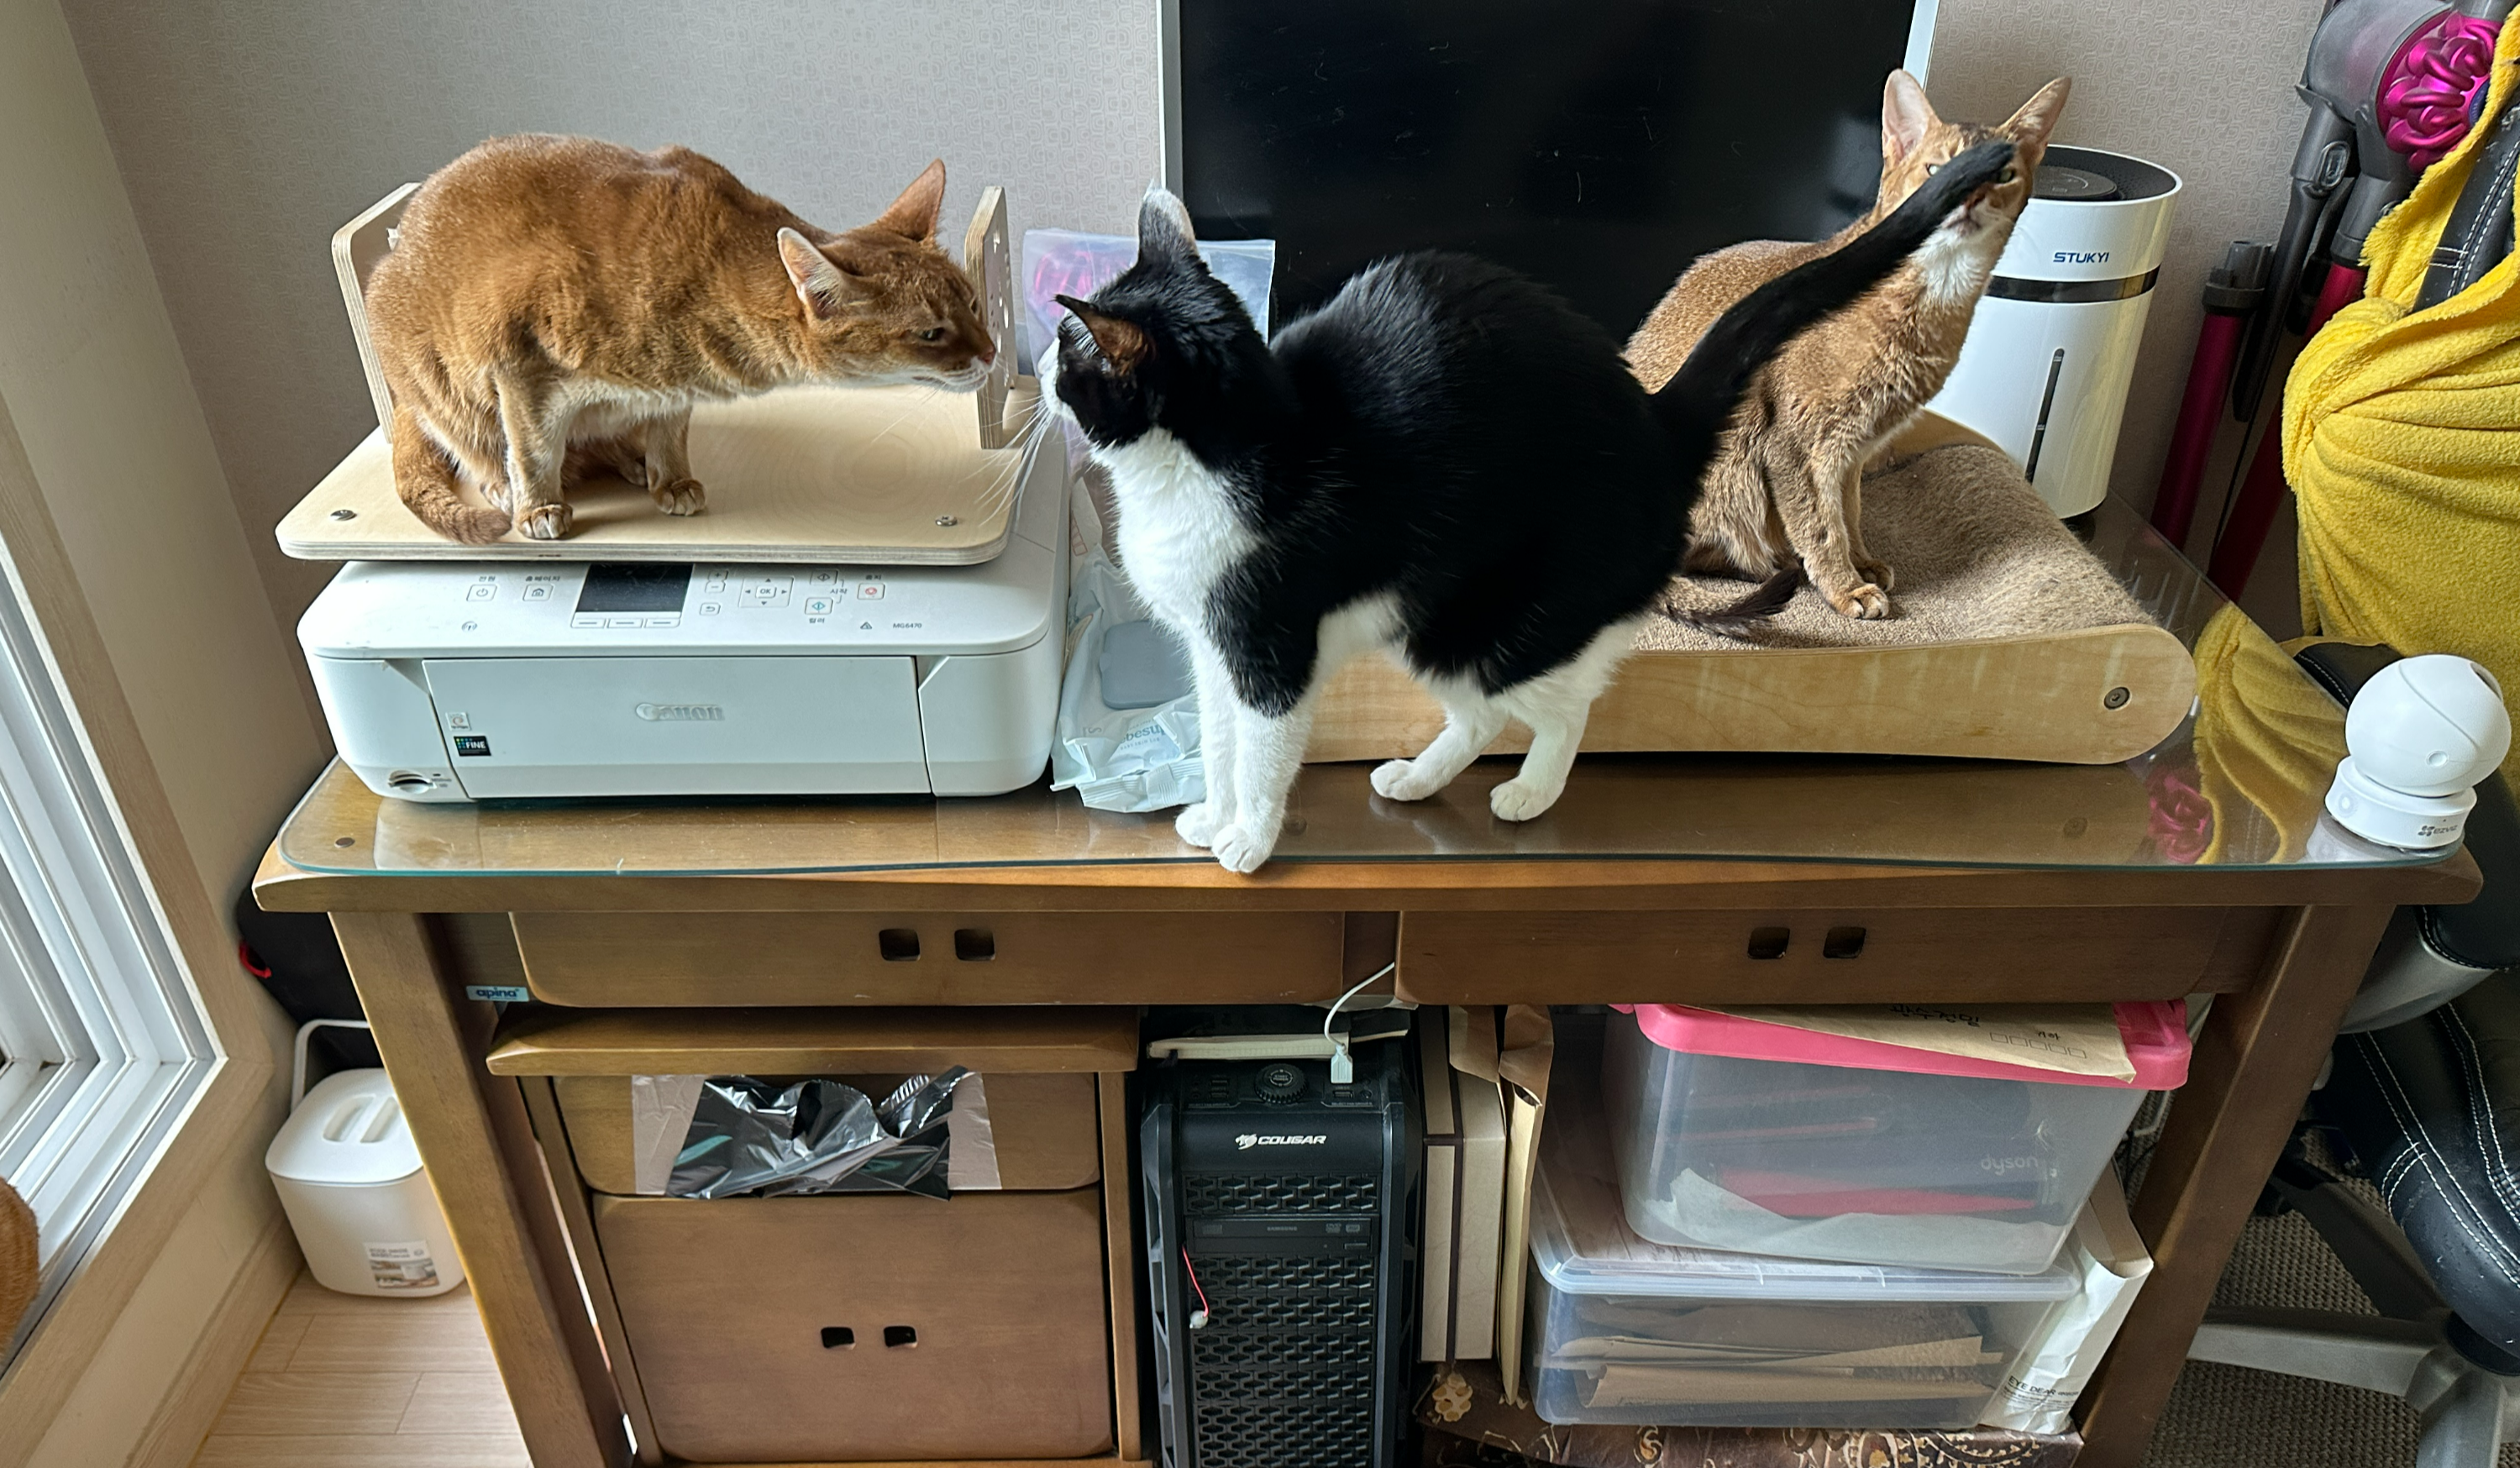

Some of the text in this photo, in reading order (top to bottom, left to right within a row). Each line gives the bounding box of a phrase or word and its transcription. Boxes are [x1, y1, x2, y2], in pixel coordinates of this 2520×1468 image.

[2053, 252, 2110, 263] STUKYI
[636, 703, 725, 721] Canon
[465, 741, 486, 749] FINE
[476, 987, 517, 999] apina
[1258, 1135, 1327, 1145] COUGAR
[1982, 1154, 2039, 1176] dyson
[2008, 1376, 2029, 1389] EYE
[2029, 1386, 2056, 1396] DEAR
